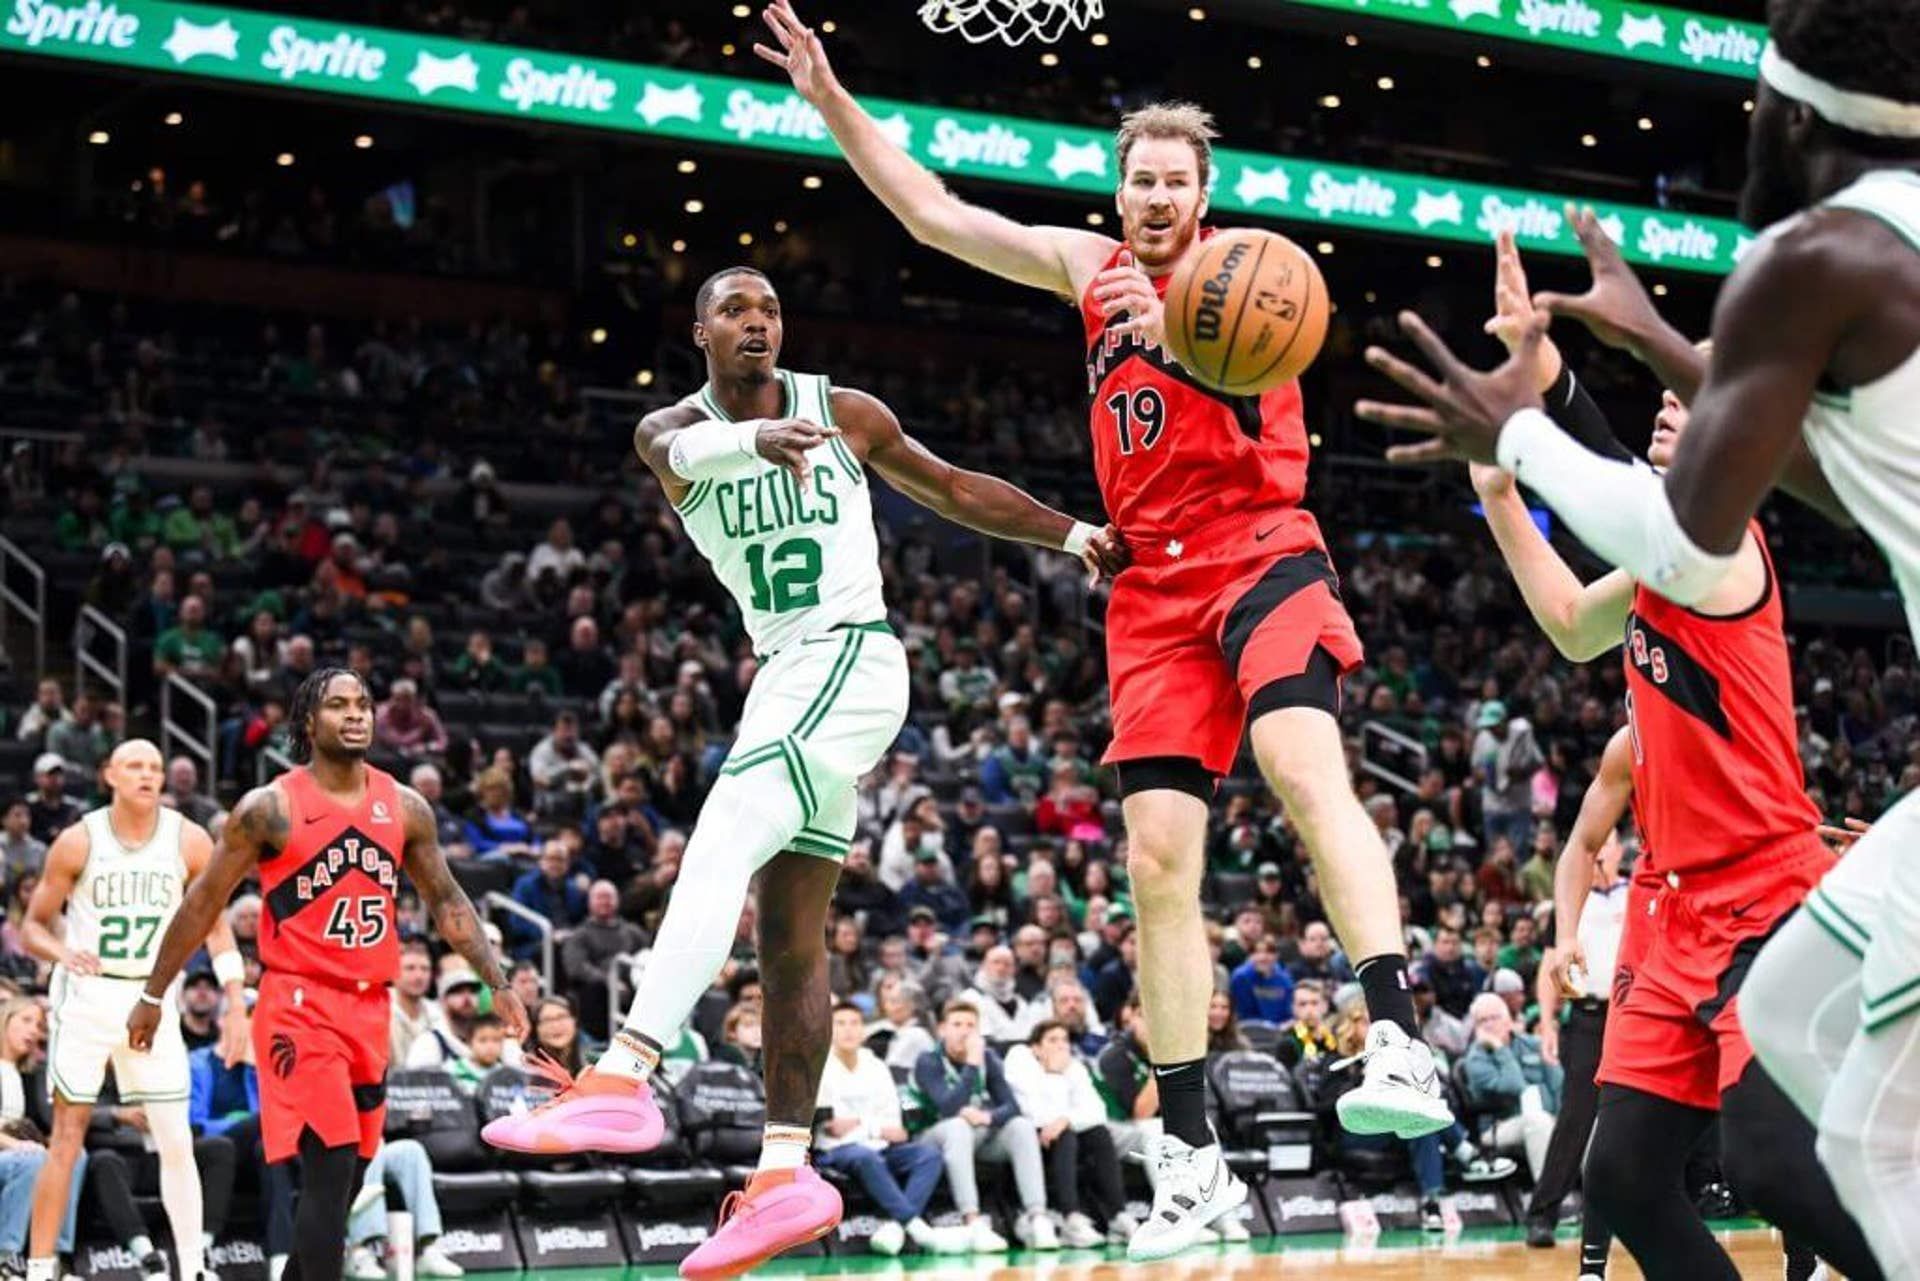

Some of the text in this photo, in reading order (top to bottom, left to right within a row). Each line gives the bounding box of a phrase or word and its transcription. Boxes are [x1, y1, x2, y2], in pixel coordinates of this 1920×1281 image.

[6, 0, 140, 47] Sprite
[1515, 0, 1601, 37] Sprite
[1679, 19, 1760, 64] Sprite
[261, 26, 386, 81] Sprite
[499, 58, 617, 112] Sprite
[927, 118, 1032, 168] Sprite
[1305, 170, 1397, 218] Sprite
[1475, 194, 1562, 240] Sprite
[1637, 216, 1718, 262] Sprite
[1194, 242, 1252, 342] Wilson
[1106, 386, 1165, 456] 19
[745, 537, 823, 614] 12
[92, 870, 174, 910] CELTICS
[98, 915, 162, 959] 27
[323, 895, 387, 949] 45
